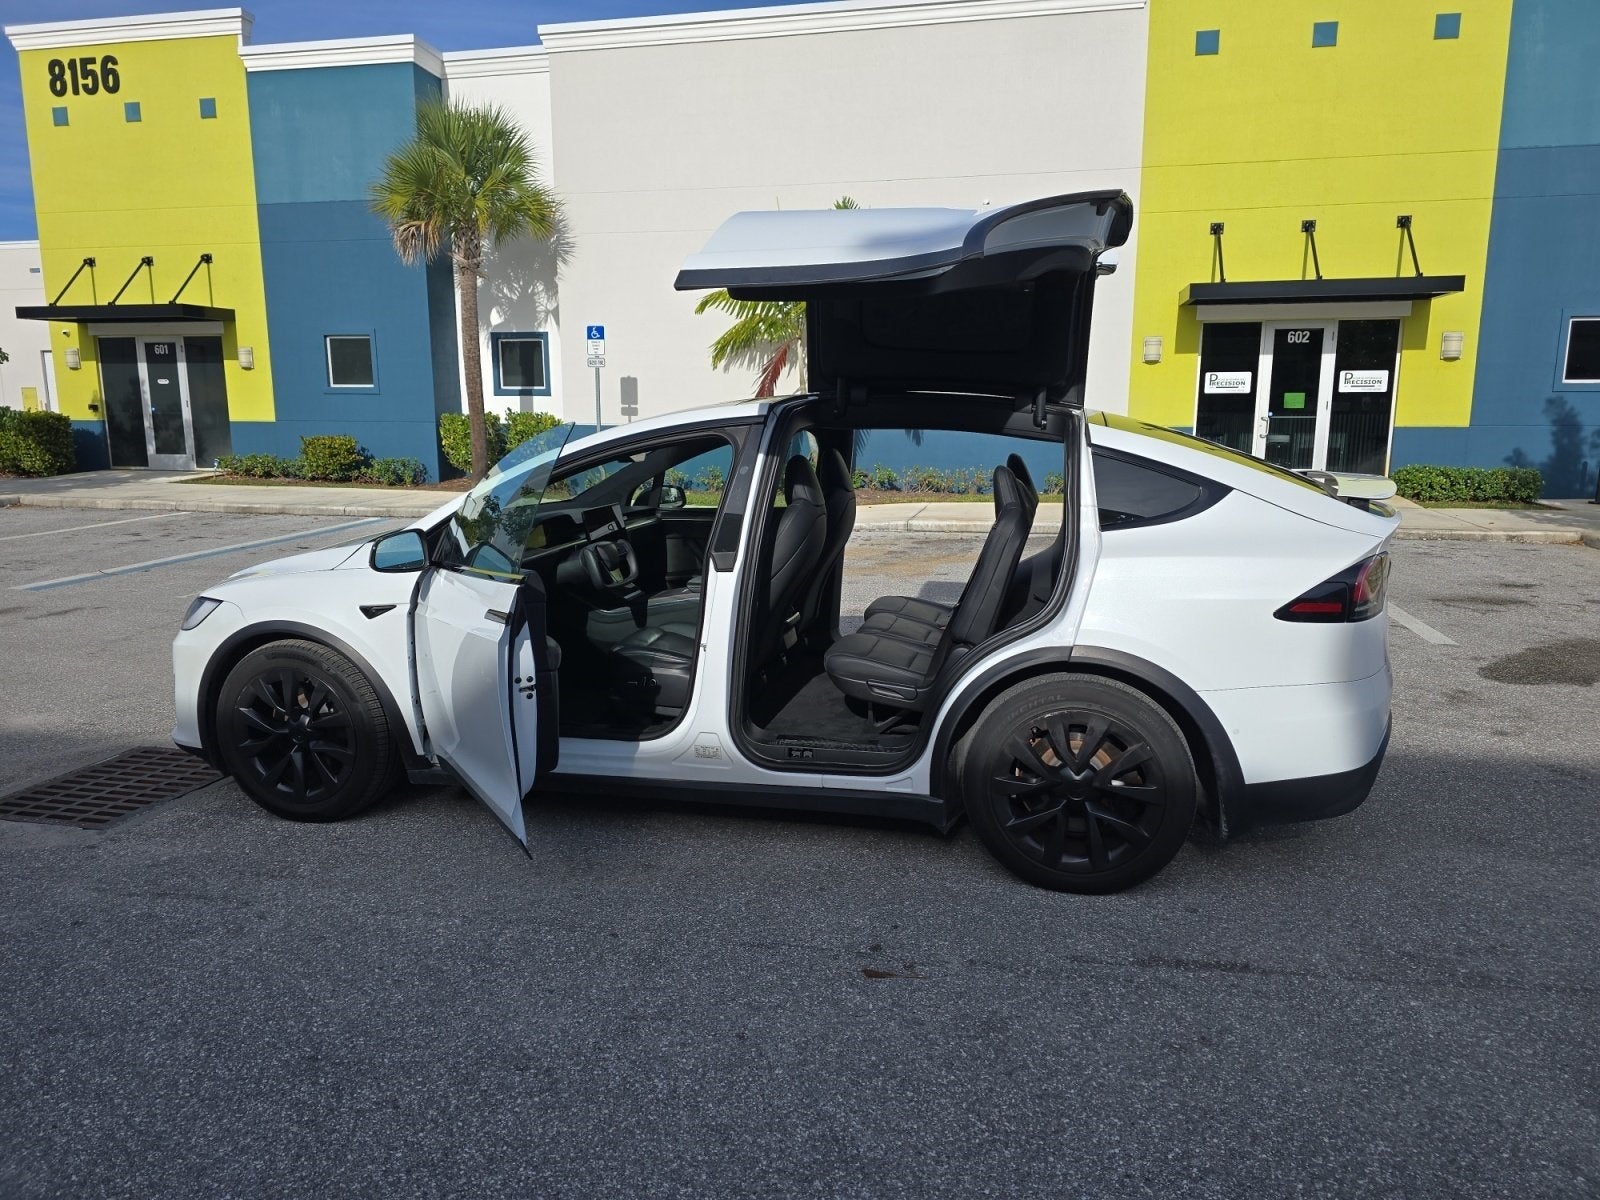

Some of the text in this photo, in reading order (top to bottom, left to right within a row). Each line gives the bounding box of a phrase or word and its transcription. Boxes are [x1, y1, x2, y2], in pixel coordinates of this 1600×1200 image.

[48, 55, 120, 97] 8156
[1287, 330, 1310, 343] 602
[154, 344, 169, 354] 601
[1209, 373, 1246, 386] PRECISION
[1343, 372, 1383, 385] PRECISION
